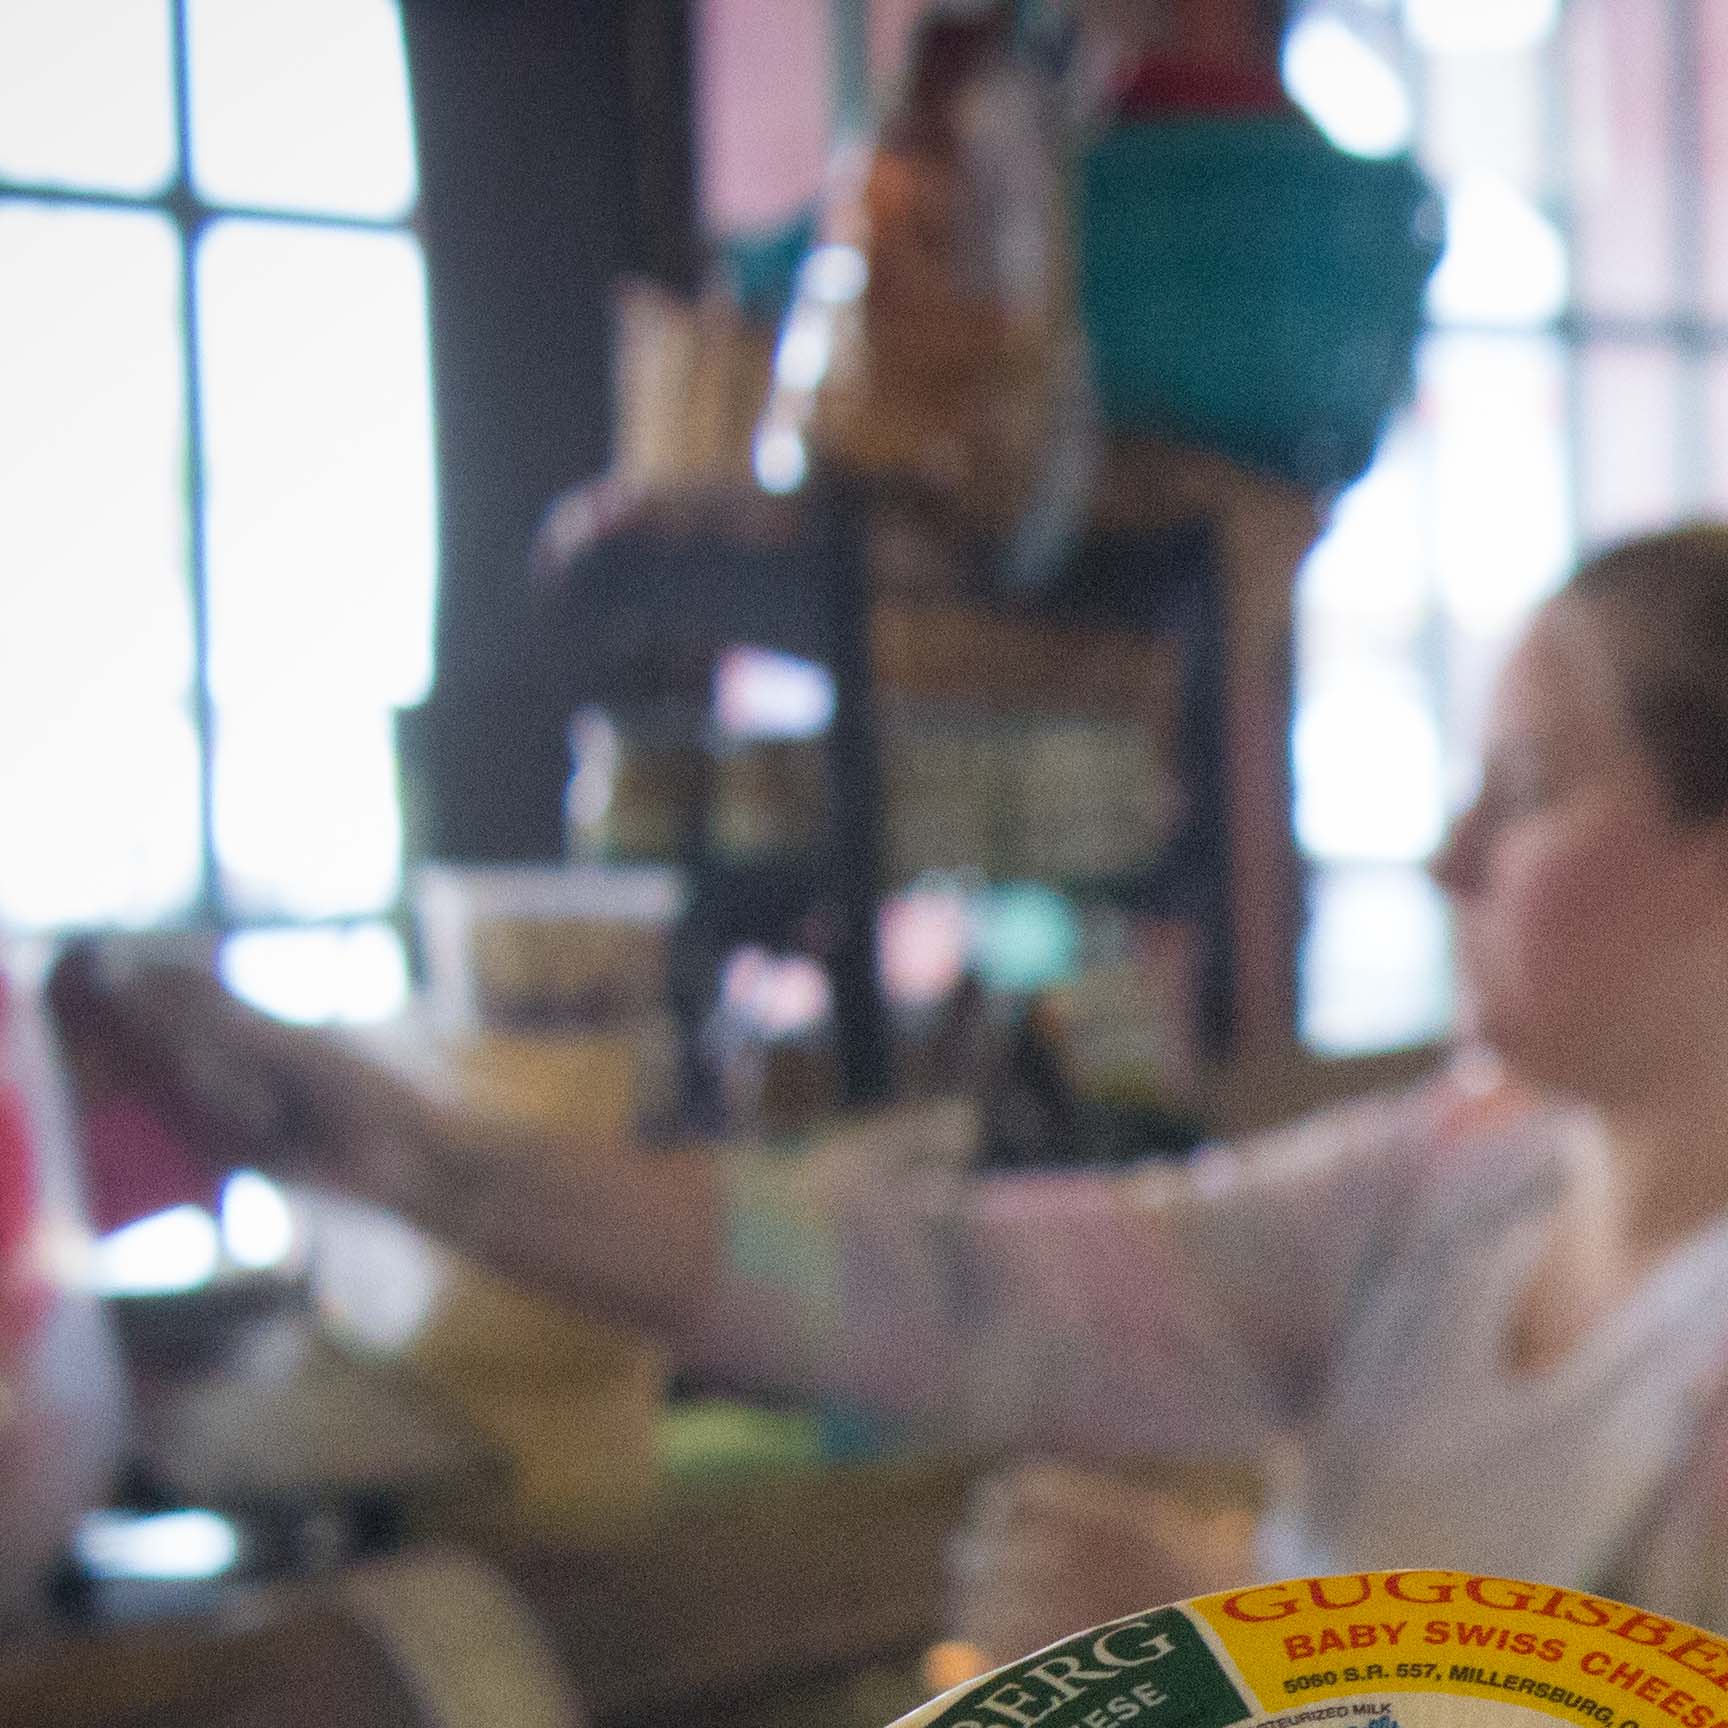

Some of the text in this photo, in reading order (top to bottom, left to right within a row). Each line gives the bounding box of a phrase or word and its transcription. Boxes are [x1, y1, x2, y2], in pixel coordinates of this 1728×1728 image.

[1283, 1621, 1408, 1662] BABY
[1424, 1621, 1567, 1662] SWISS
[1283, 1671, 1337, 1694] 5060
[1344, 1664, 1389, 1681] S.R.
[1396, 1663, 1442, 1681] 557,
[1450, 1664, 1612, 1728] MILLERSBURG,
[1352, 1703, 1392, 1715] MILK
